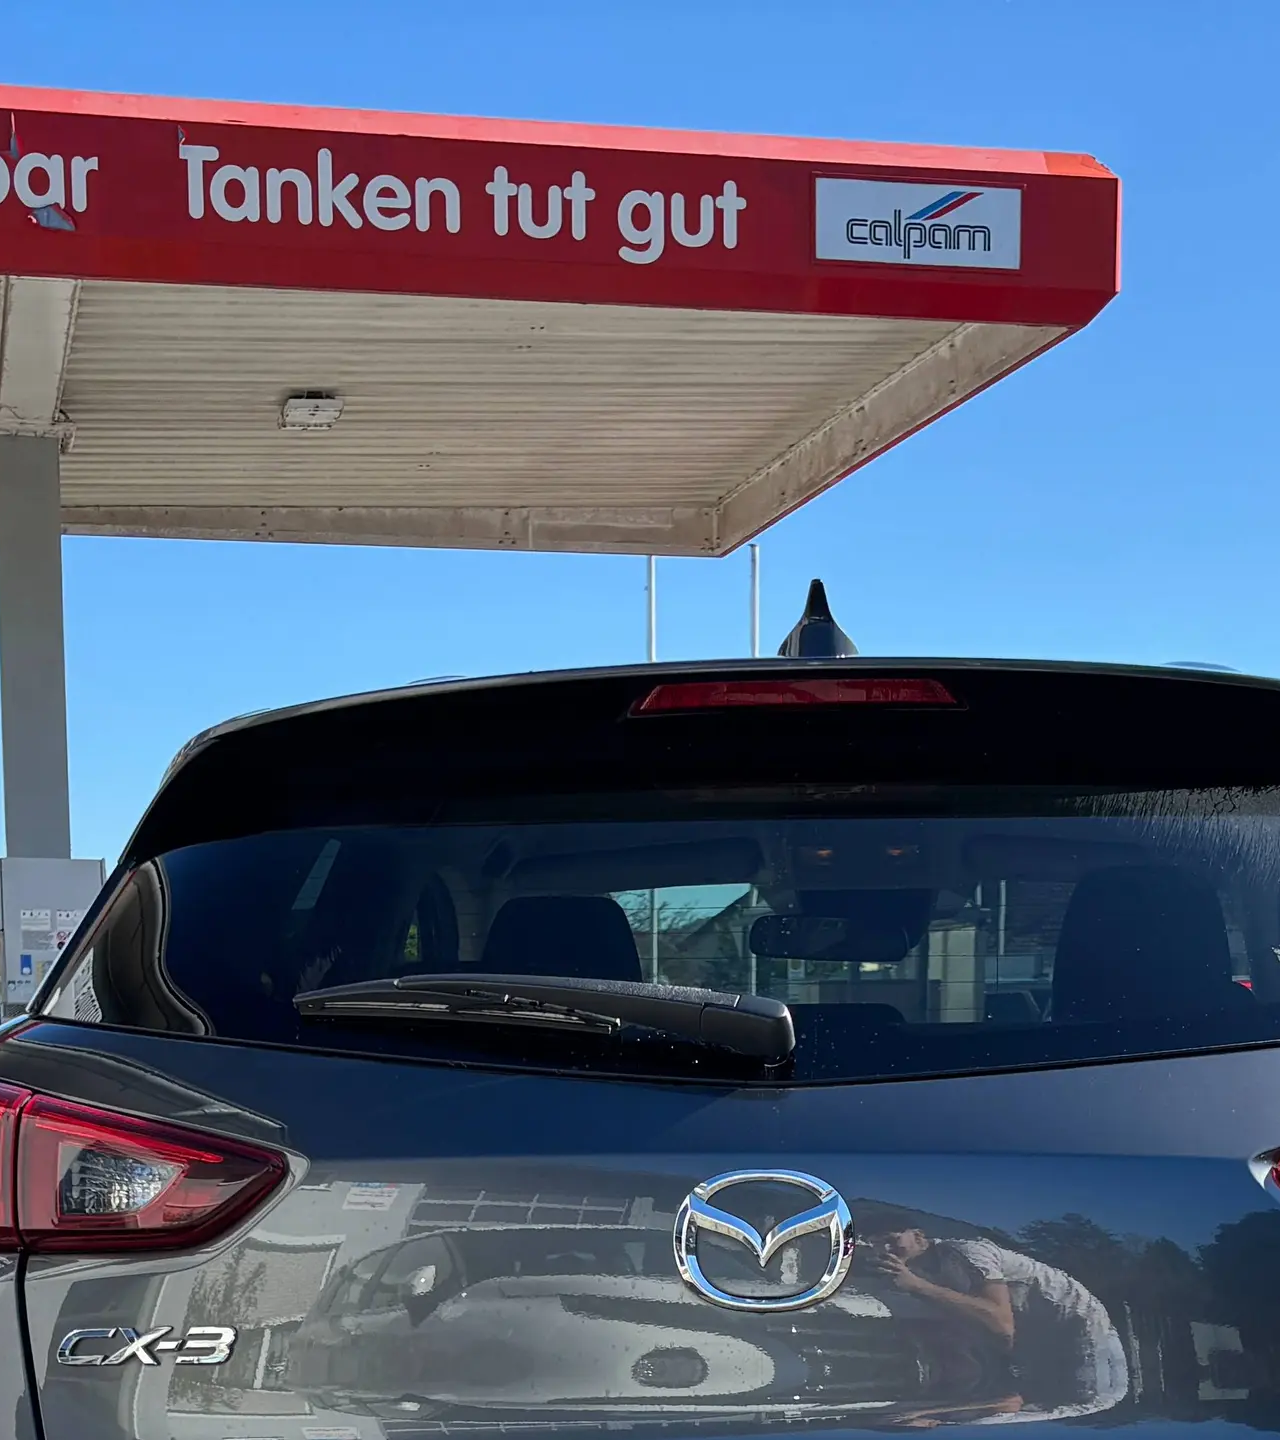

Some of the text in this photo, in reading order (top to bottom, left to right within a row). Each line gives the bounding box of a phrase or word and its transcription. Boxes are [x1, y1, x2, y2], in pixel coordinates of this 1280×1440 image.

[179, 144, 461, 234] Tanken
[485, 165, 596, 241] tut
[617, 180, 747, 264] gut
[845, 208, 992, 260] calpam
[57, 1325, 238, 1366] CX-3
